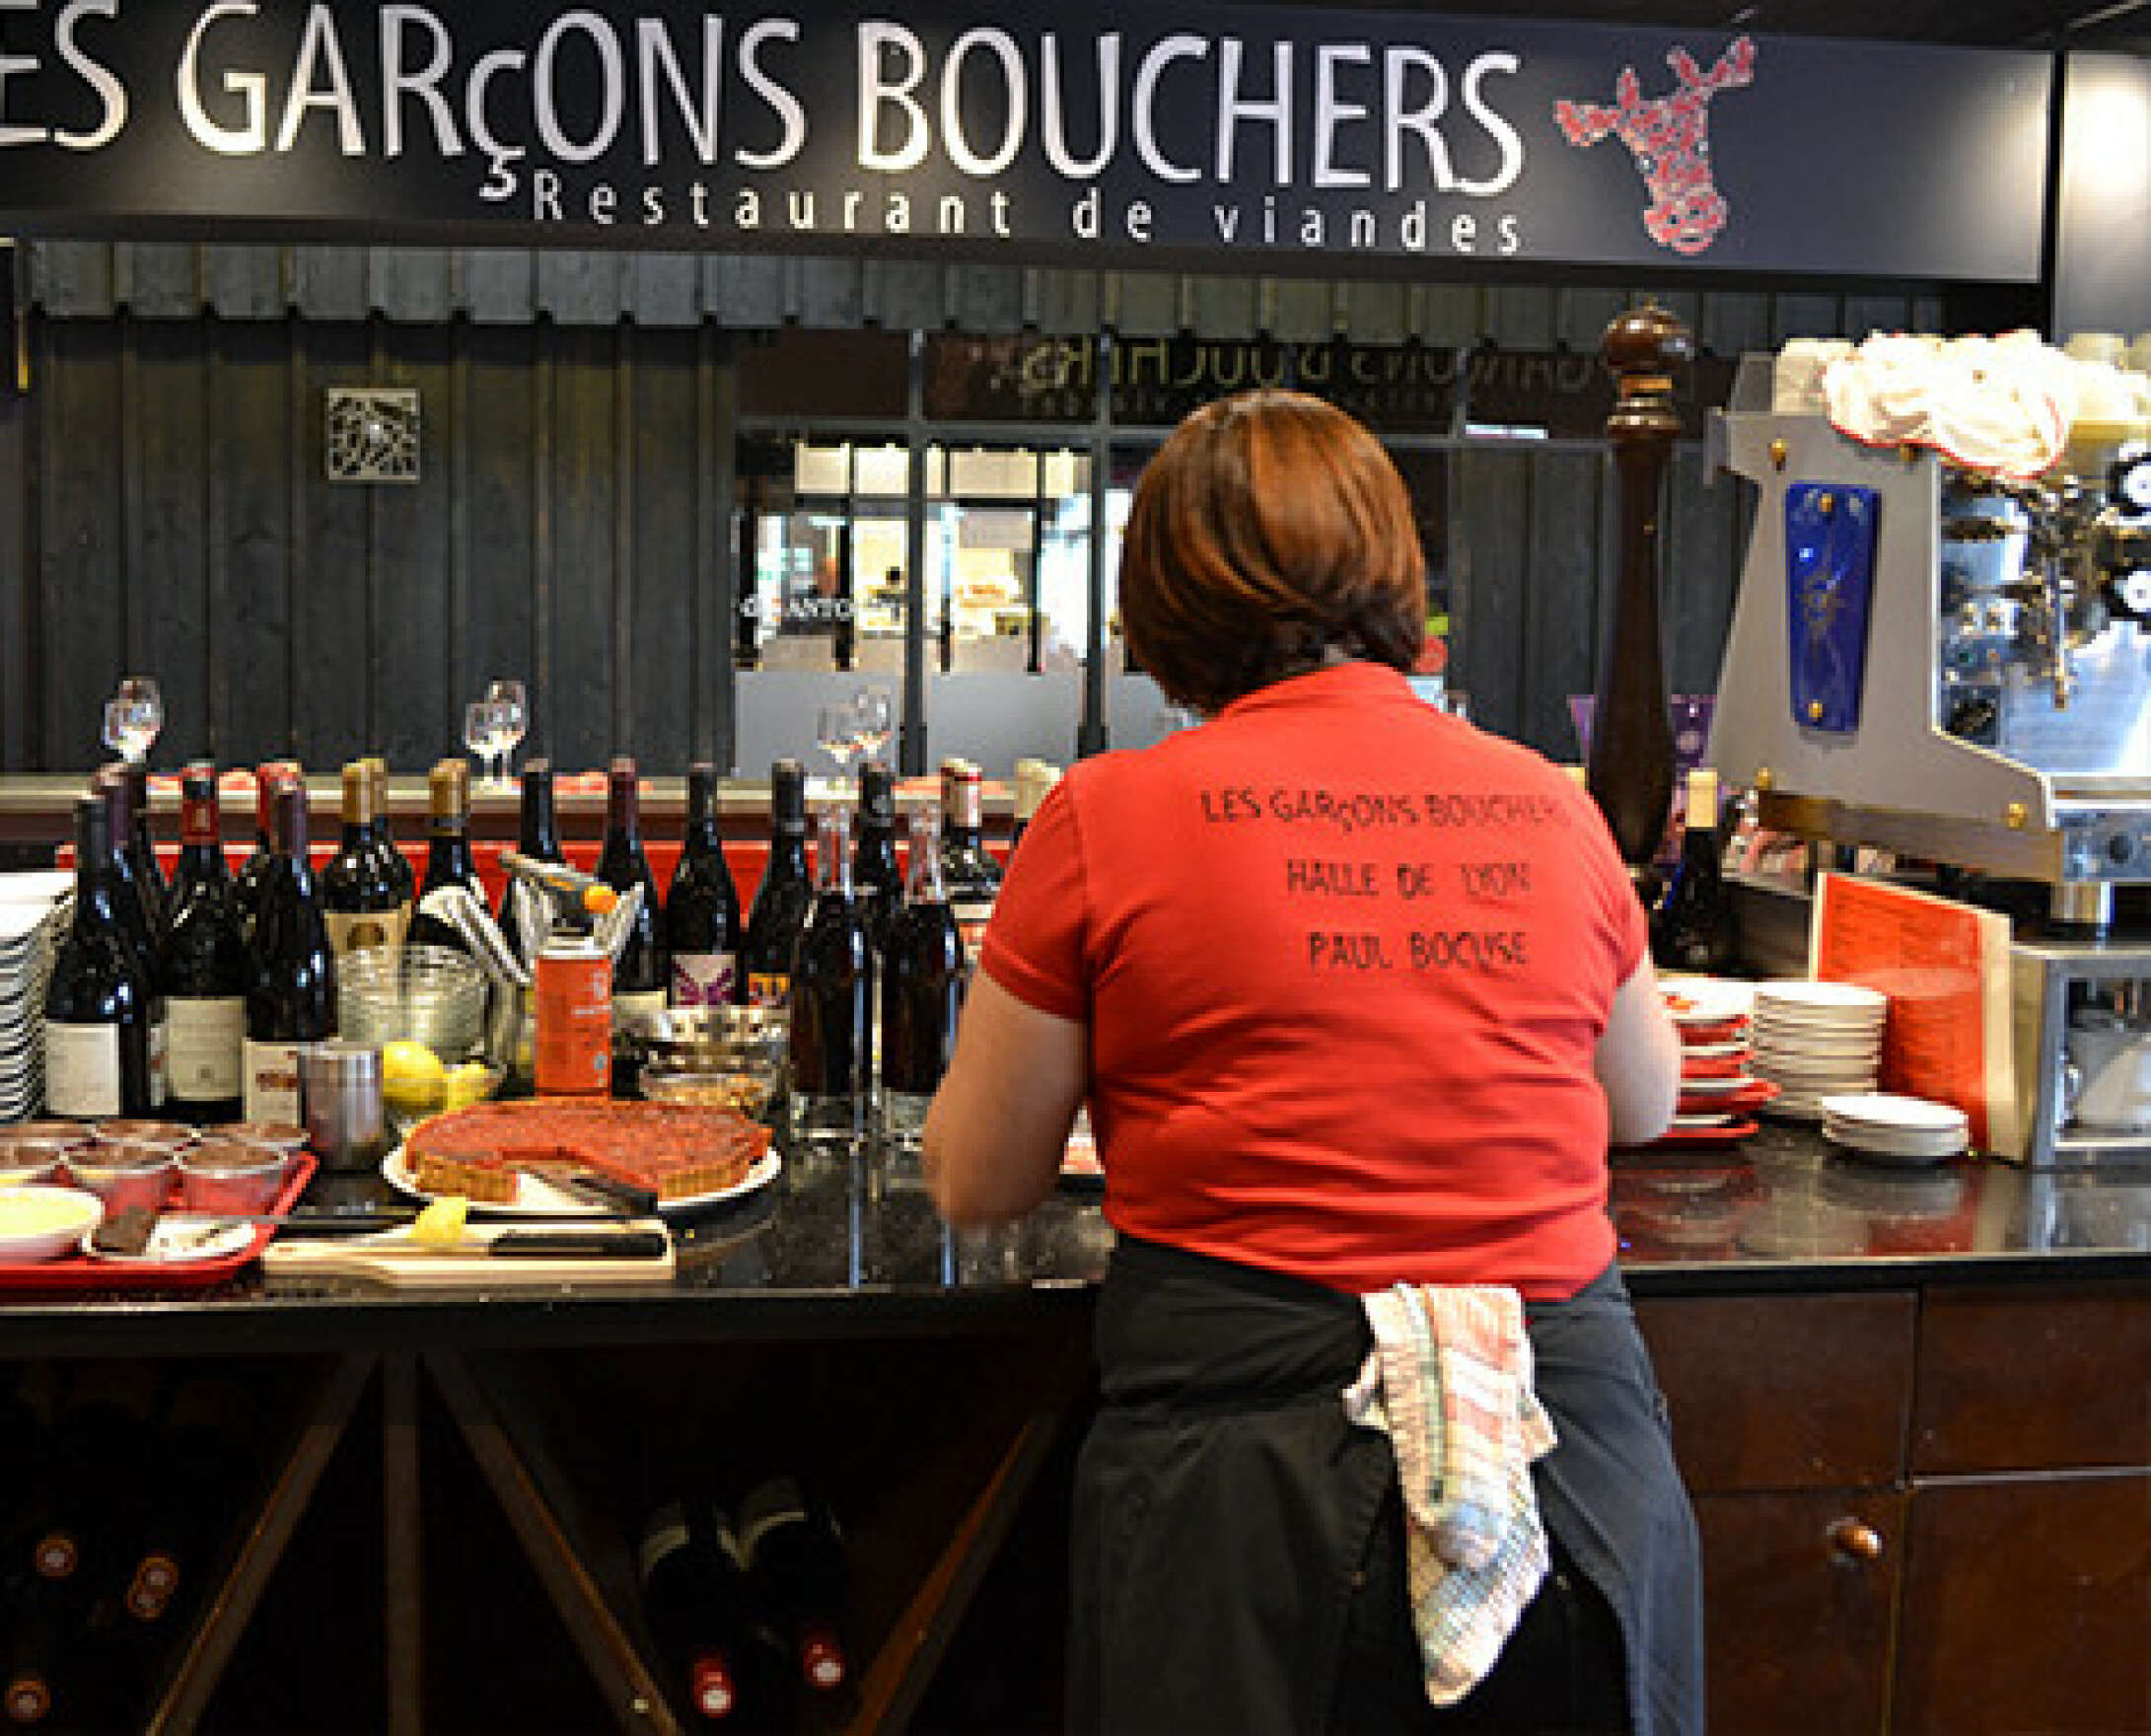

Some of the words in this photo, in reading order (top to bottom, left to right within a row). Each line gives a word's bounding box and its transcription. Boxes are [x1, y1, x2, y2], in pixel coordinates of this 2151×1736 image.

[856, 20, 1526, 198] BOUCHERS
[533, 169, 1013, 239] Restaurant
[1072, 186, 1153, 243] de
[1214, 199, 1522, 256] viandes
[1200, 786, 1261, 823] LES
[1286, 859, 1380, 897] HALLE
[1397, 862, 1435, 900] DE
[1306, 931, 1394, 969] PAUL
[1406, 931, 1531, 970] BOCUSE
